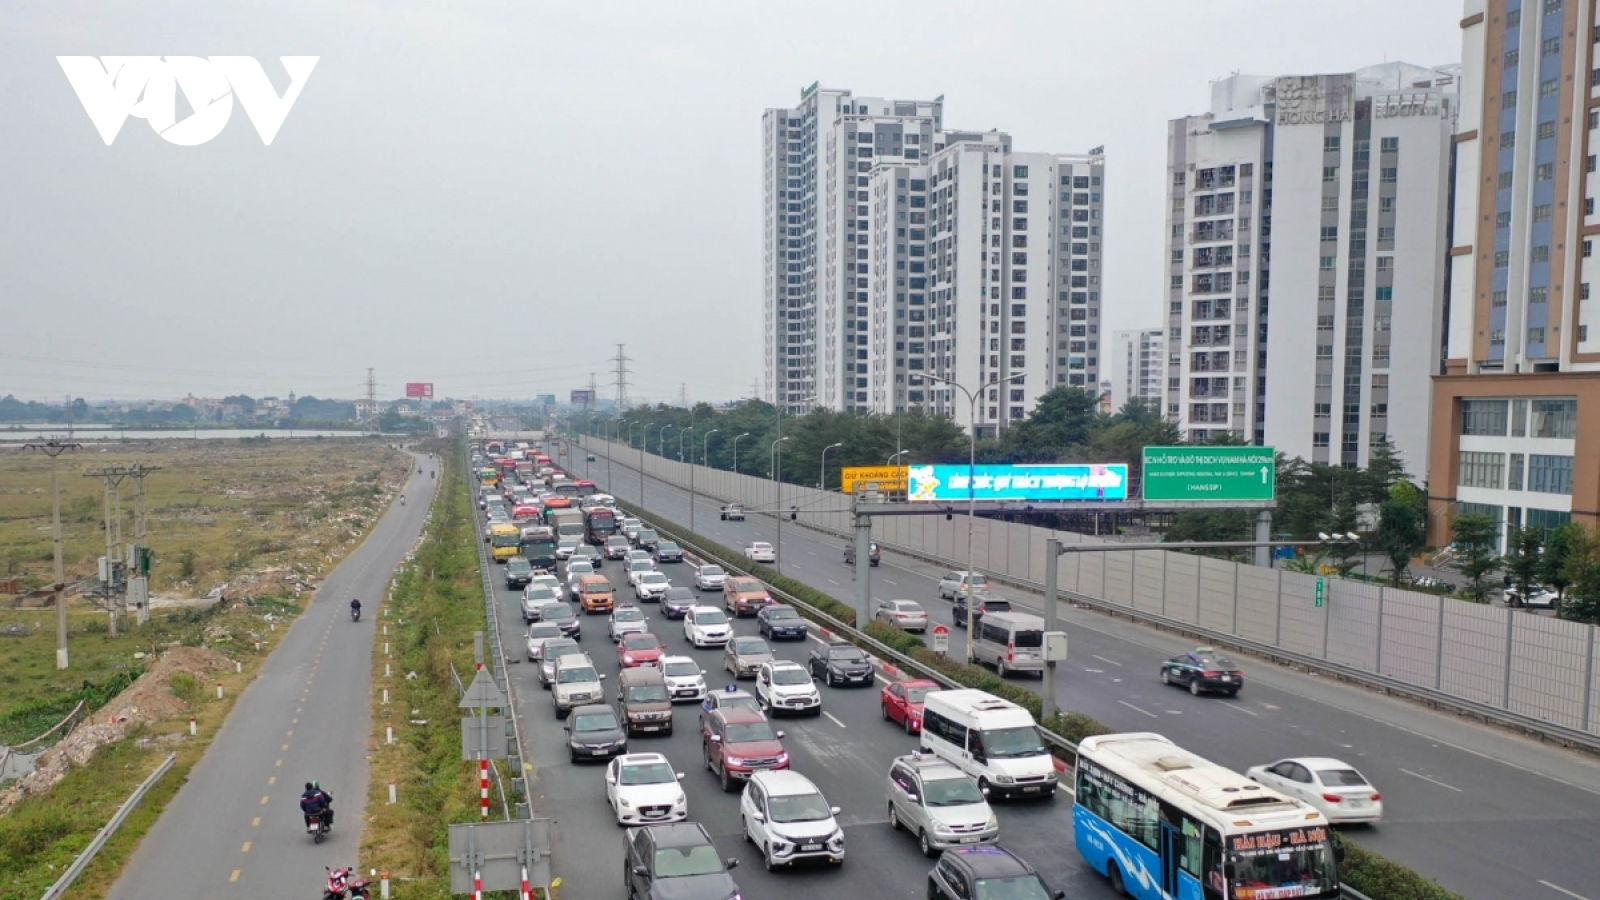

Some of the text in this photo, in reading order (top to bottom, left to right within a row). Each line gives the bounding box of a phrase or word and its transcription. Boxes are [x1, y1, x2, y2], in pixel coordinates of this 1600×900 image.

[1234, 834, 1256, 850] HẢI
[1256, 832, 1280, 849] HẬU
[1290, 829, 1308, 844] HÀ
[1308, 827, 1326, 842] NỘI
